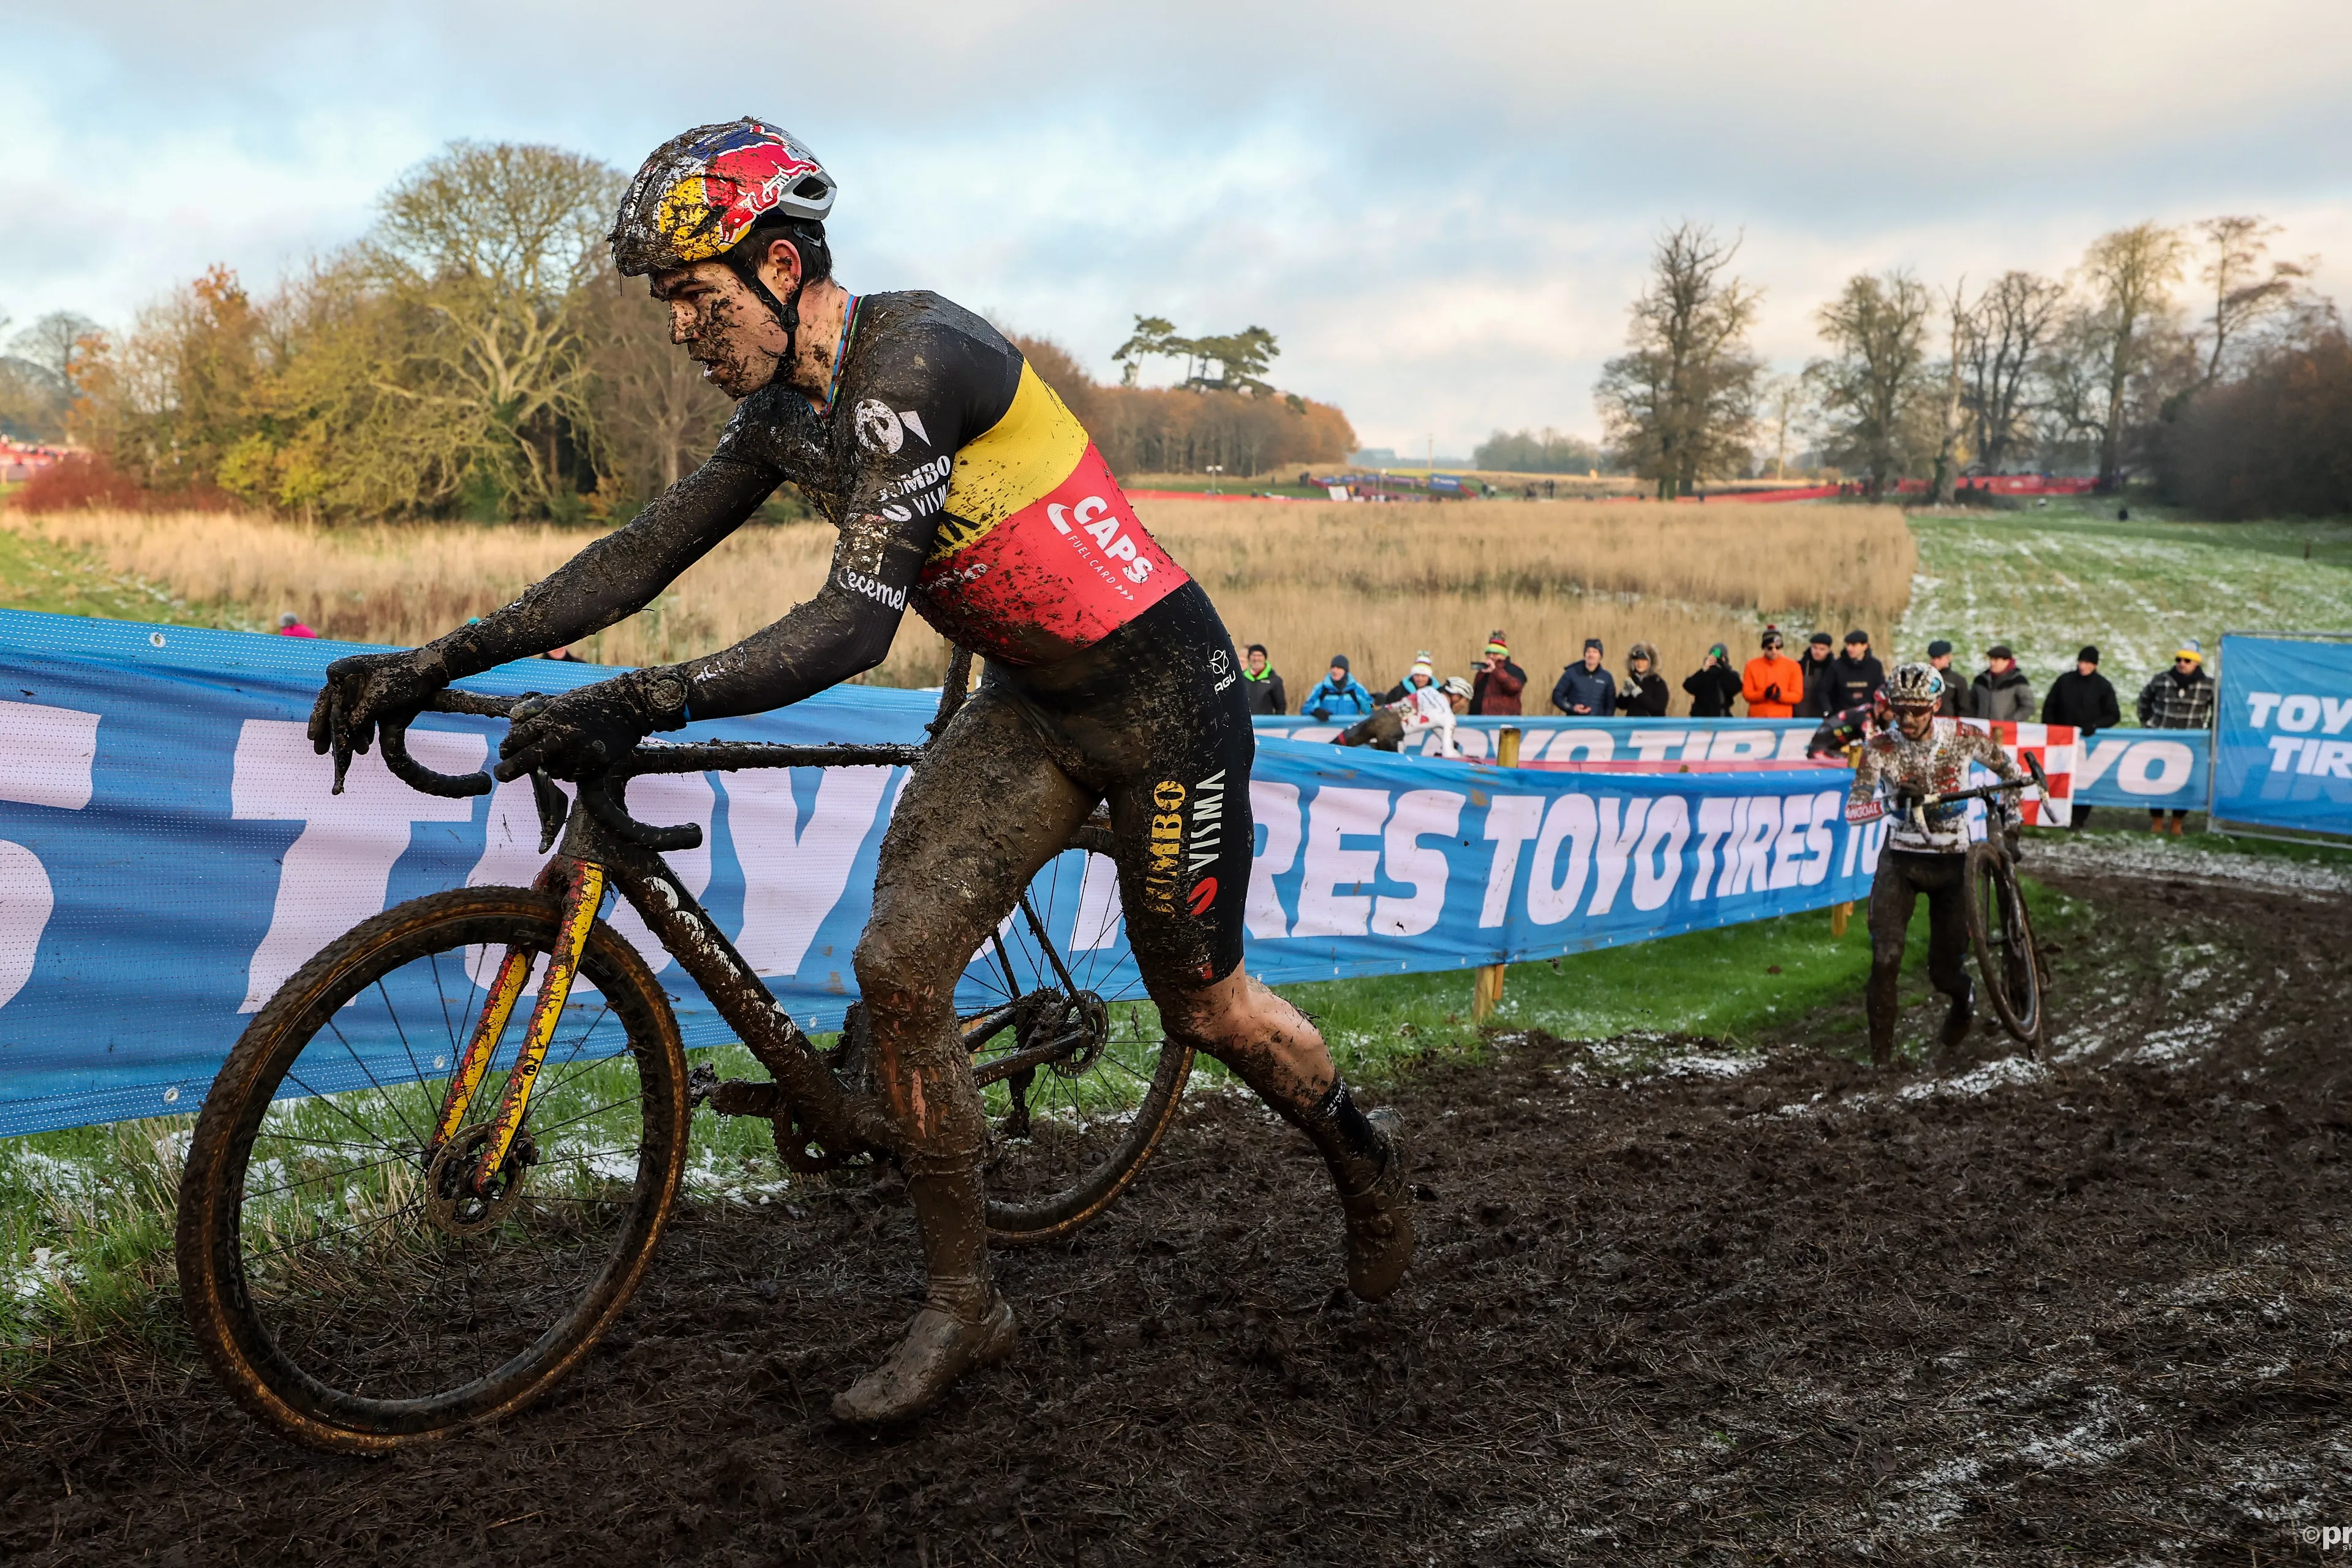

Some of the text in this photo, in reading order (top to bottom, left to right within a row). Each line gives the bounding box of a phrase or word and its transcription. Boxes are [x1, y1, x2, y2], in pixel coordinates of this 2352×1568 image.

[1068, 535, 1117, 584] FUEL CARD
[1073, 496, 1153, 584] CAPS
[1214, 670, 1236, 695] AGU
[2268, 735, 2352, 779] TIR
[1188, 769, 1225, 872] VISMA
[1479, 793, 1691, 929] TOYO
[1690, 791, 1842, 902] TIRES
